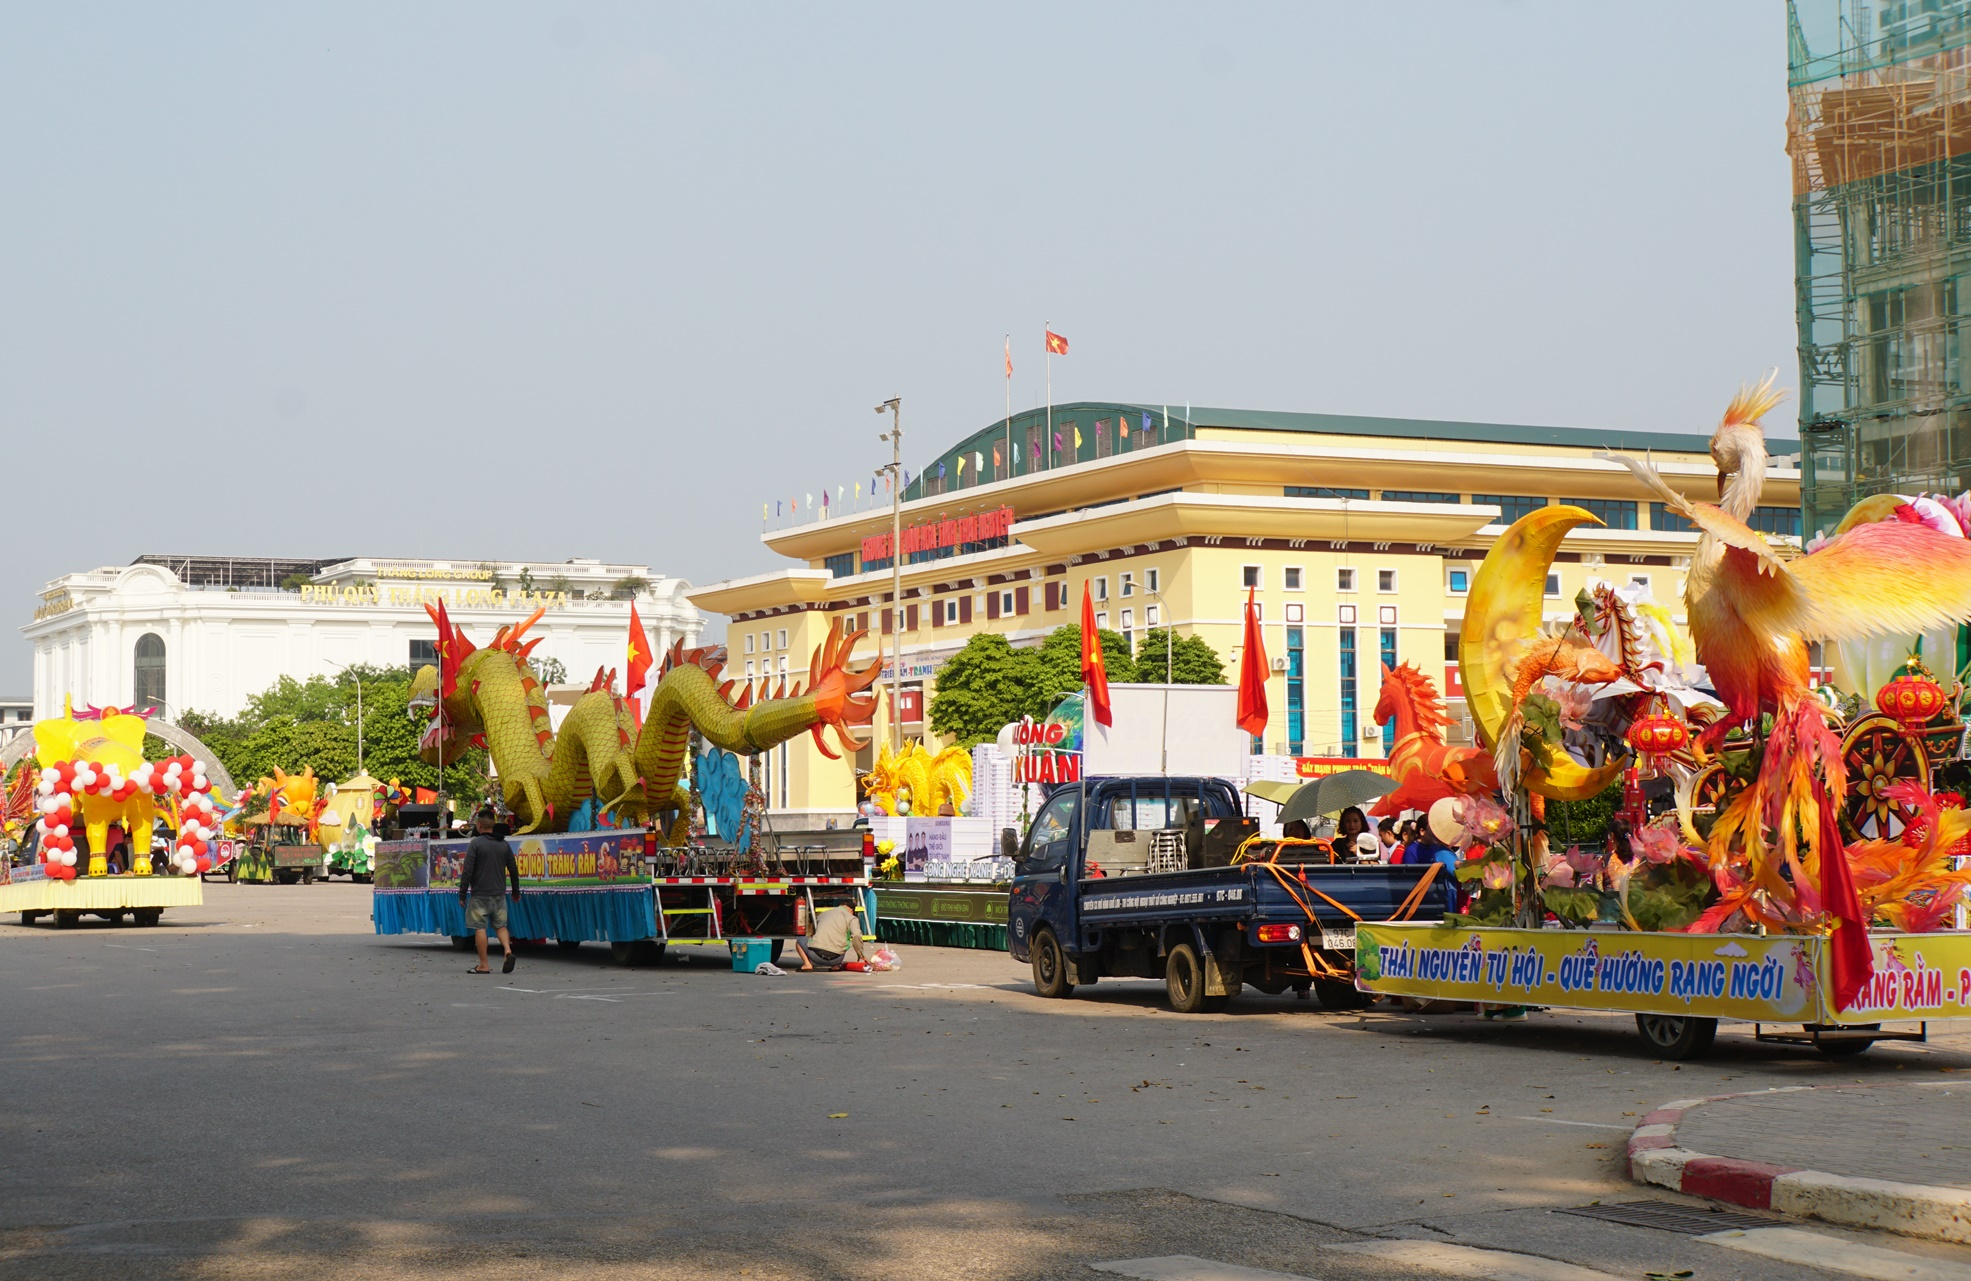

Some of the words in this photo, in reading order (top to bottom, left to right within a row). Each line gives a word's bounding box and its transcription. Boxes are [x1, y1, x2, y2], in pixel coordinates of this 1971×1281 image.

[378, 566, 416, 578] THĂNG
[418, 569, 451, 578] LONG
[454, 570, 492, 580] GROUP
[300, 580, 339, 602] PHÚ
[344, 582, 380, 603] QUÝ
[388, 584, 450, 604] THĂNG
[456, 590, 503, 605] LONG
[509, 590, 568, 607] PLAZA
[1013, 750, 1080, 783] XUÂN
[531, 848, 545, 882] HỘI
[547, 848, 576, 878] TRĂNG
[578, 842, 596, 877] RẰM
[970, 862, 992, 878] XANH
[1332, 929, 1350, 937] 97C
[1380, 939, 1414, 978] THÁI
[1418, 944, 1482, 982] NGUYÊN
[1486, 951, 1508, 992] TỤ
[1511, 946, 1544, 992] HỘI
[1560, 950, 1596, 992] QUÊ
[1600, 951, 1664, 994] HƯƠNG
[1670, 960, 1725, 1004] RẠNG
[1730, 955, 1784, 1000] NGỜI
[1903, 953, 1941, 1010] RẰM
